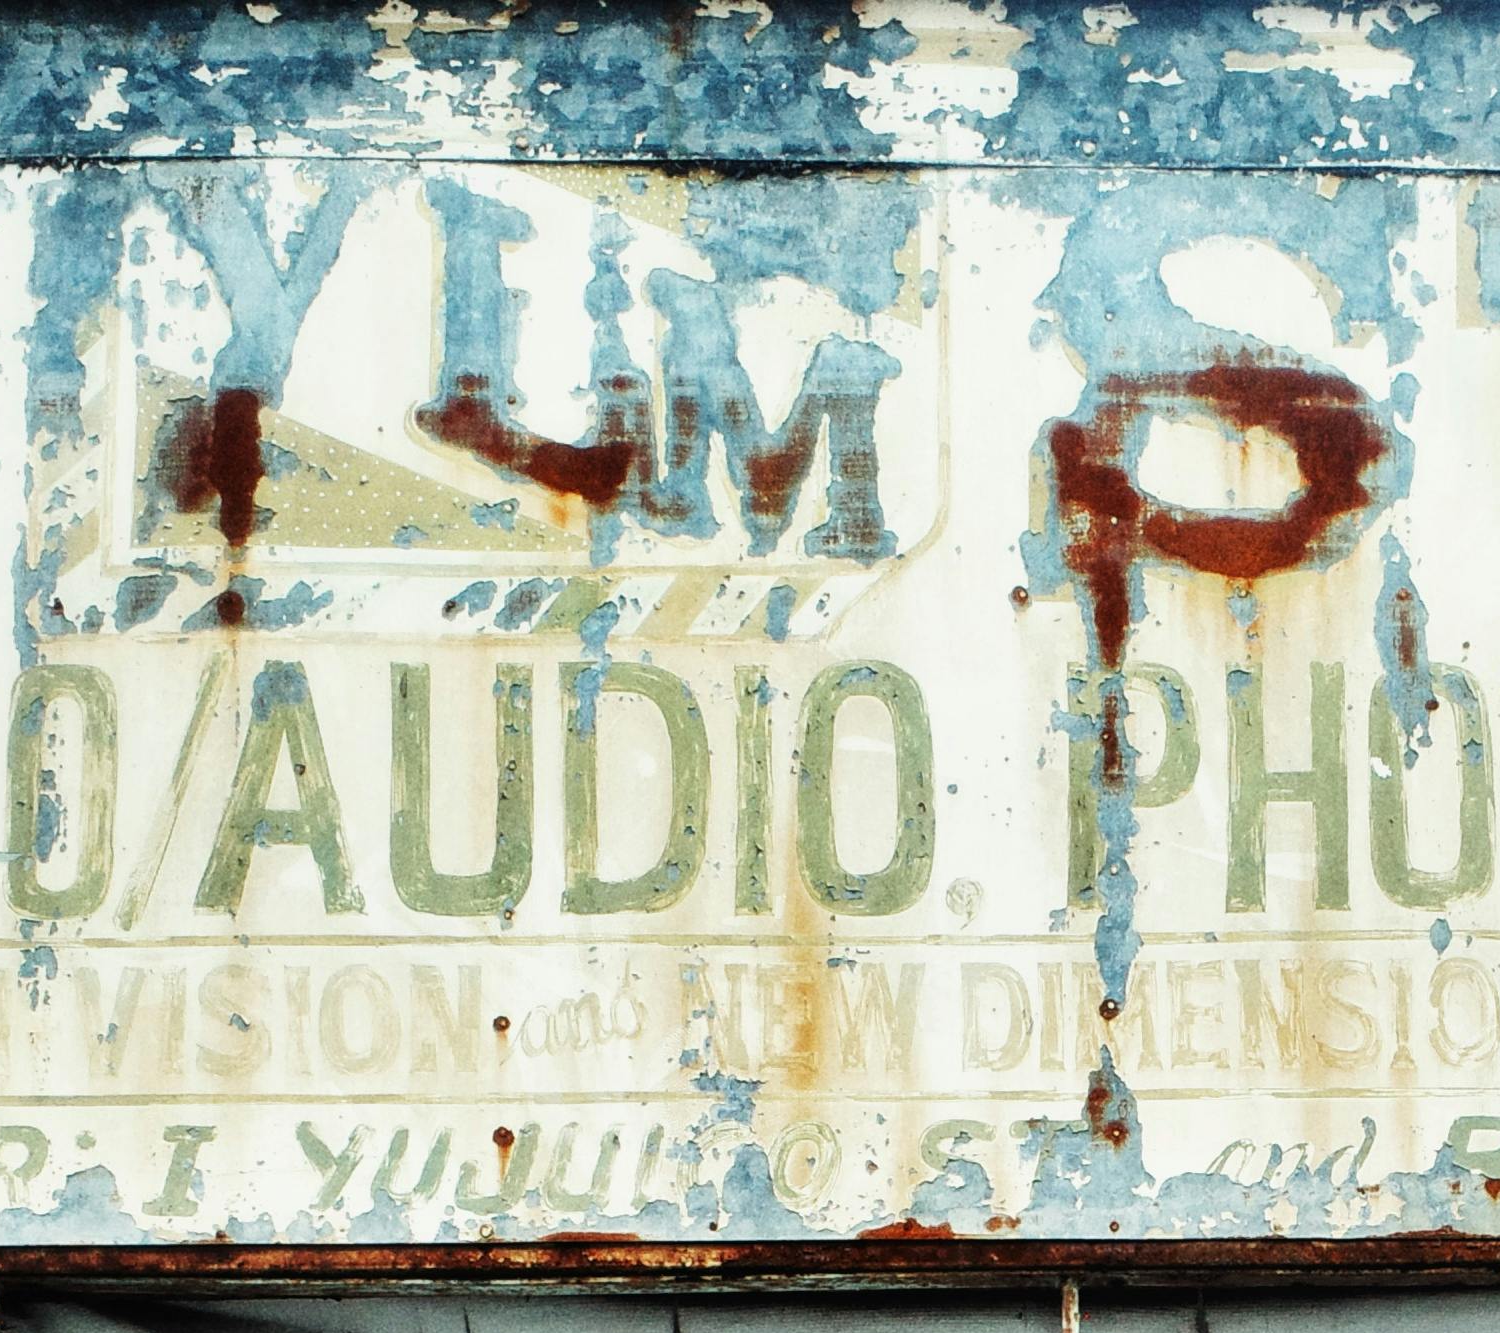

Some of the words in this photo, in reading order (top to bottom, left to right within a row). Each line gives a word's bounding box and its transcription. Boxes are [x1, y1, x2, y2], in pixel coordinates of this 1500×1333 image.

[78, 962, 483, 1078] VISION
[503, 957, 646, 1064] and
[680, 960, 927, 1074] NEW
